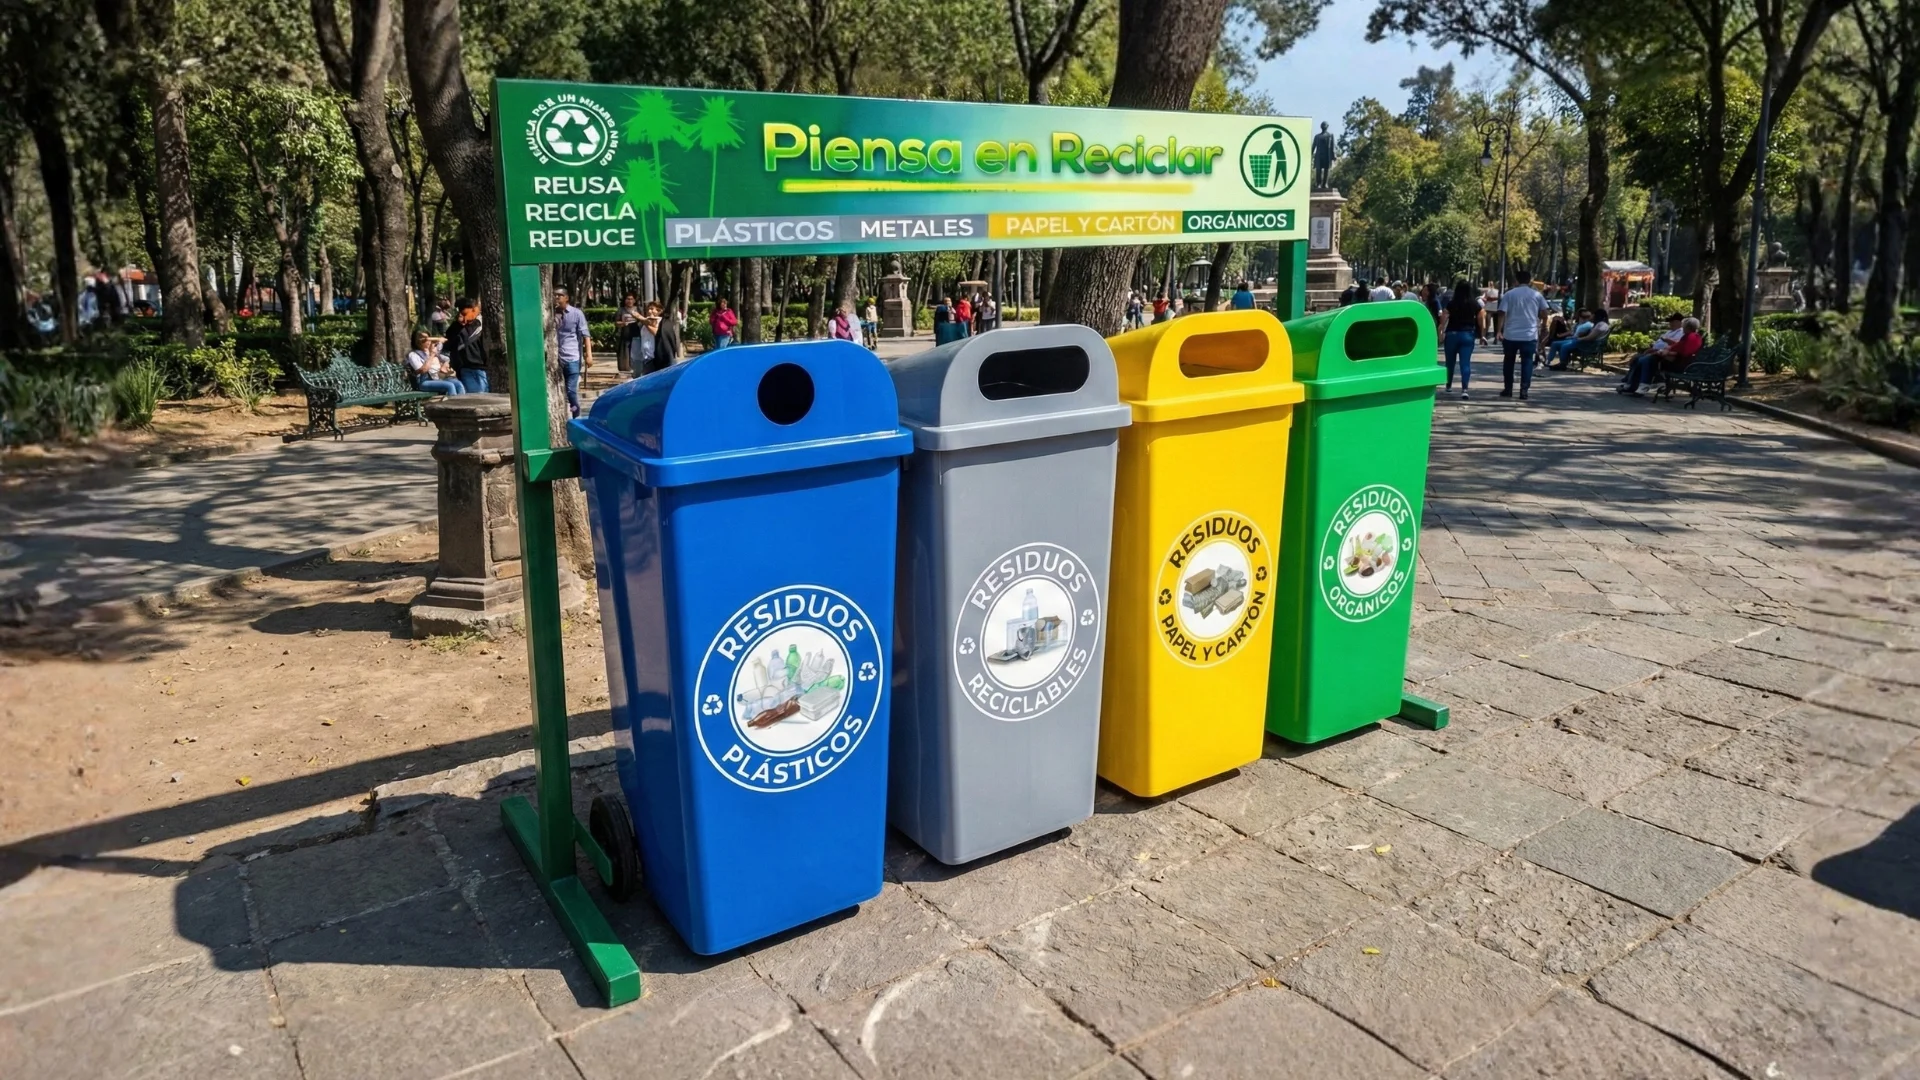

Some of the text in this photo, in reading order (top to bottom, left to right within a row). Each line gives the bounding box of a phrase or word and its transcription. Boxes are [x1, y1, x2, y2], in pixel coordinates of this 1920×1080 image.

[763, 122, 1224, 175] Piensa en Reciclar
[533, 176, 625, 195] REUSA
[525, 203, 637, 222] RECICLA
[674, 211, 1288, 245] PLÁSTICOS METALES PAPEL Y CARTÓN ORGÁNICOS
[529, 228, 636, 248] REDUCE
[1333, 490, 1409, 536] RESIDUOS
[1169, 517, 1261, 568] RESIDUOS
[970, 551, 1087, 610] RESIDUOS
[1329, 570, 1404, 617] ORGÁNICOS
[716, 594, 864, 661] RESIDUOS
[1161, 614, 1197, 661] PAPEL
[1202, 645, 1213, 661] Y
[968, 647, 1087, 714] RECICLABLES
[721, 714, 863, 784] PLÁSTICOS
